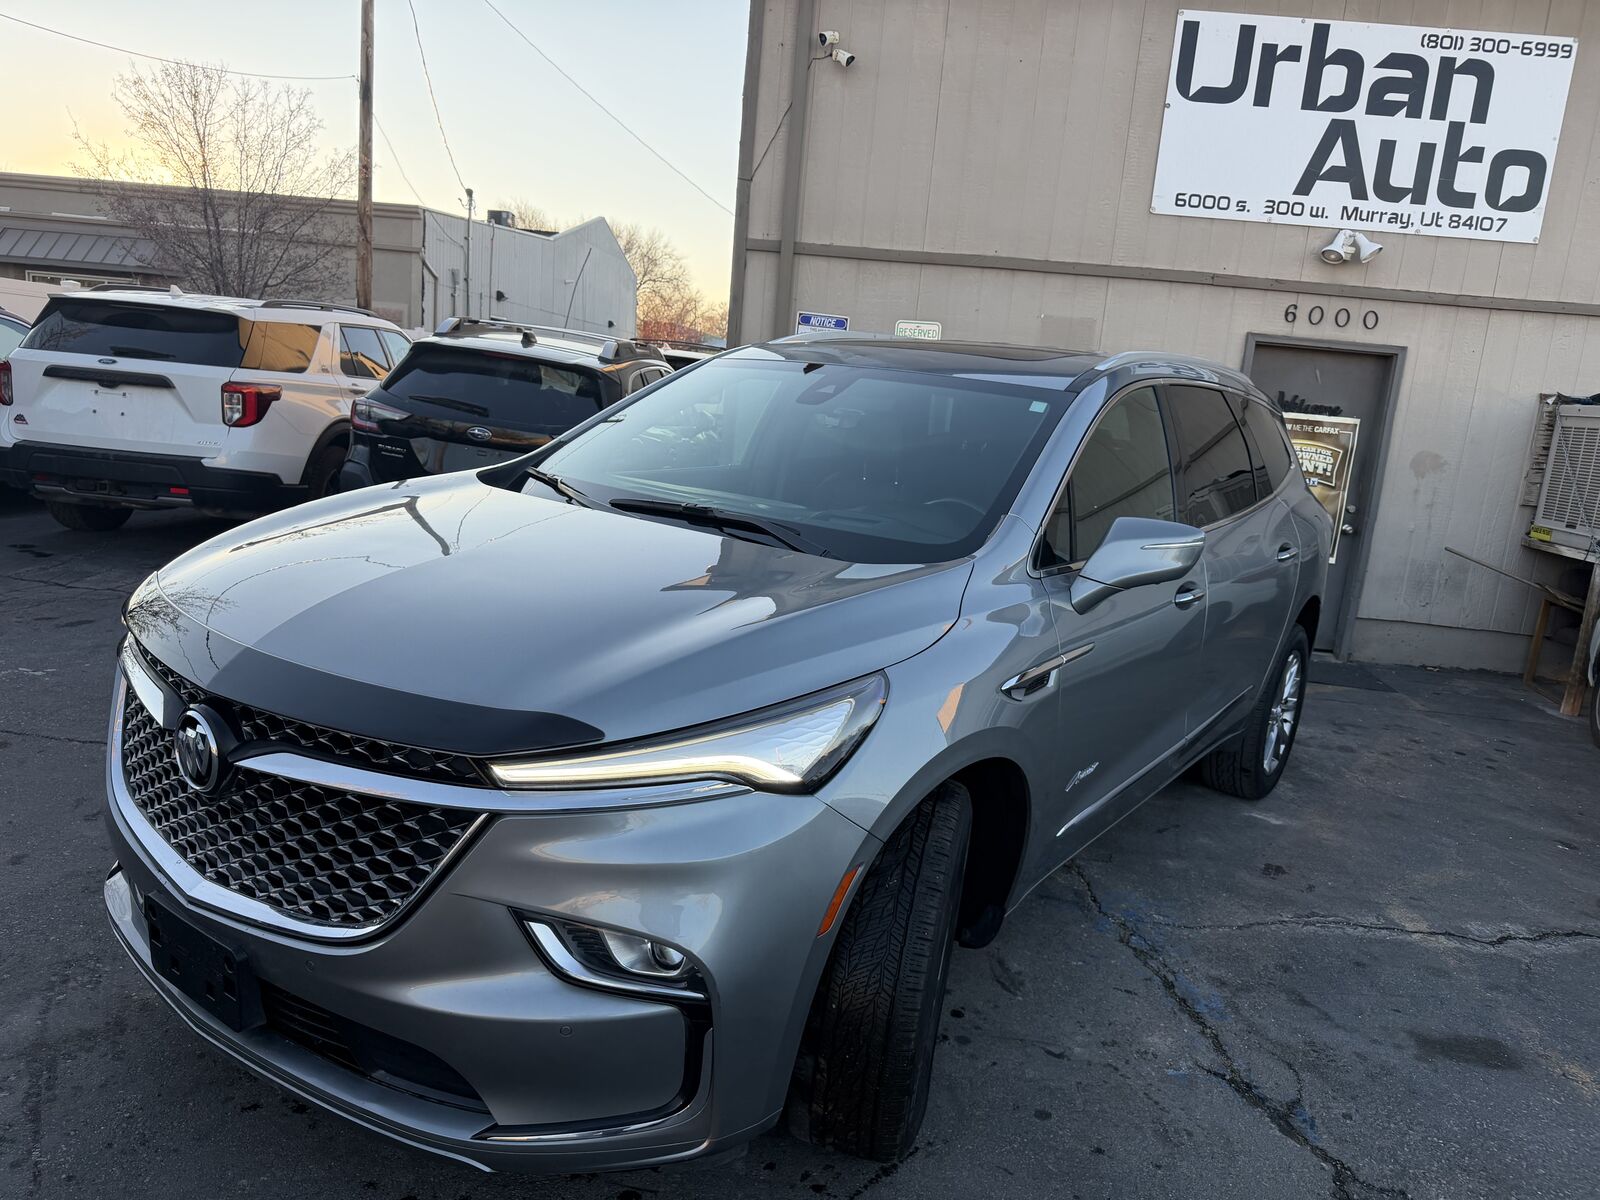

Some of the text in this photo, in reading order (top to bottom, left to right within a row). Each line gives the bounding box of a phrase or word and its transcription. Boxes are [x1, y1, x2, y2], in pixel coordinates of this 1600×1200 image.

[1420, 33, 1573, 59] (801) 300-6999
[1176, 20, 1495, 124] Urban
[1292, 118, 1548, 213] Auto
[1174, 192, 1231, 211] 6000
[1263, 199, 1305, 217] 300
[1340, 205, 1415, 229] Murray,
[1420, 211, 1444, 228] Ut
[1448, 213, 1508, 233] 84107
[809, 315, 837, 328] NOTICE
[1284, 303, 1379, 330] 6000
[898, 327, 938, 339] RESERVED
[1314, 426, 1340, 435] CARFAX
